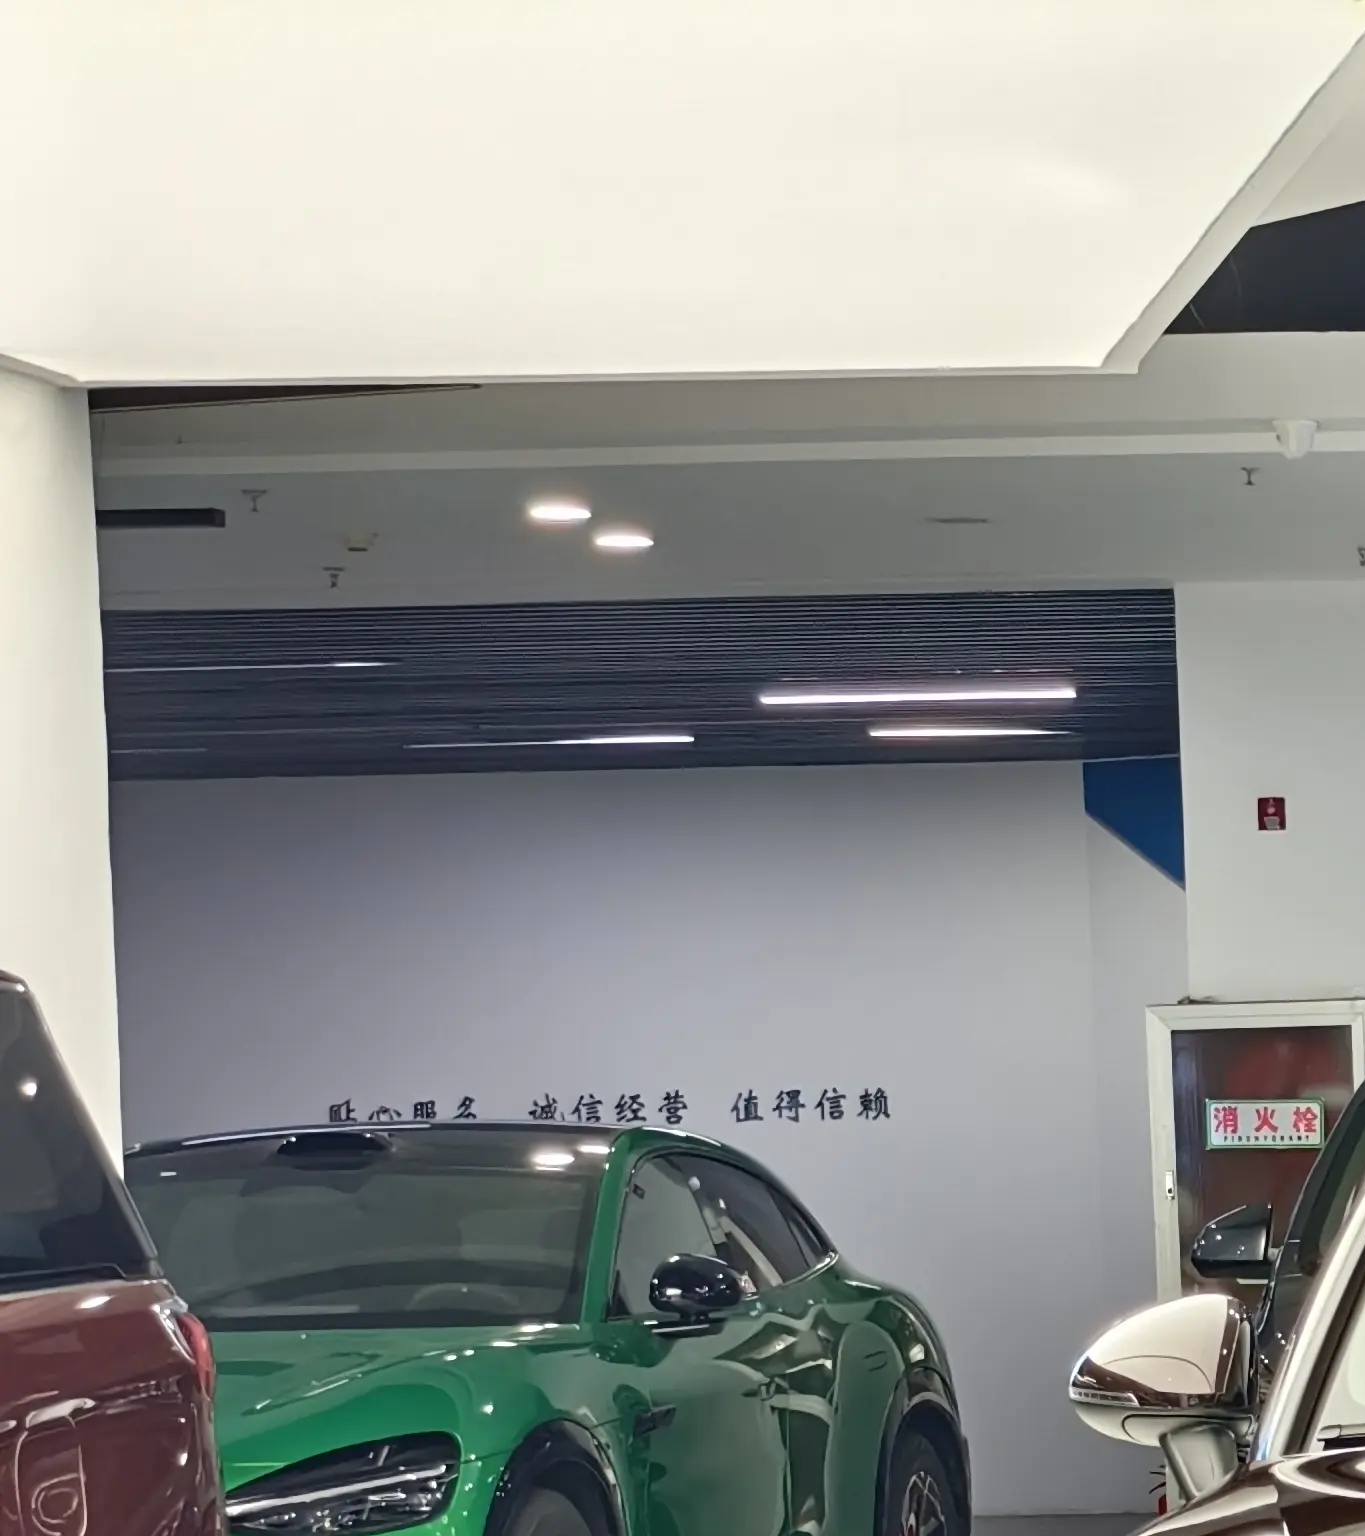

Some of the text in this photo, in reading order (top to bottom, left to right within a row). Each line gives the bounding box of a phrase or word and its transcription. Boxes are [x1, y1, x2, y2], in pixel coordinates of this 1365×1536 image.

[528, 1090, 689, 1124] 诚信经营
[731, 1087, 891, 1123] 值得信赖
[1213, 1105, 1318, 1134] 消火栓
